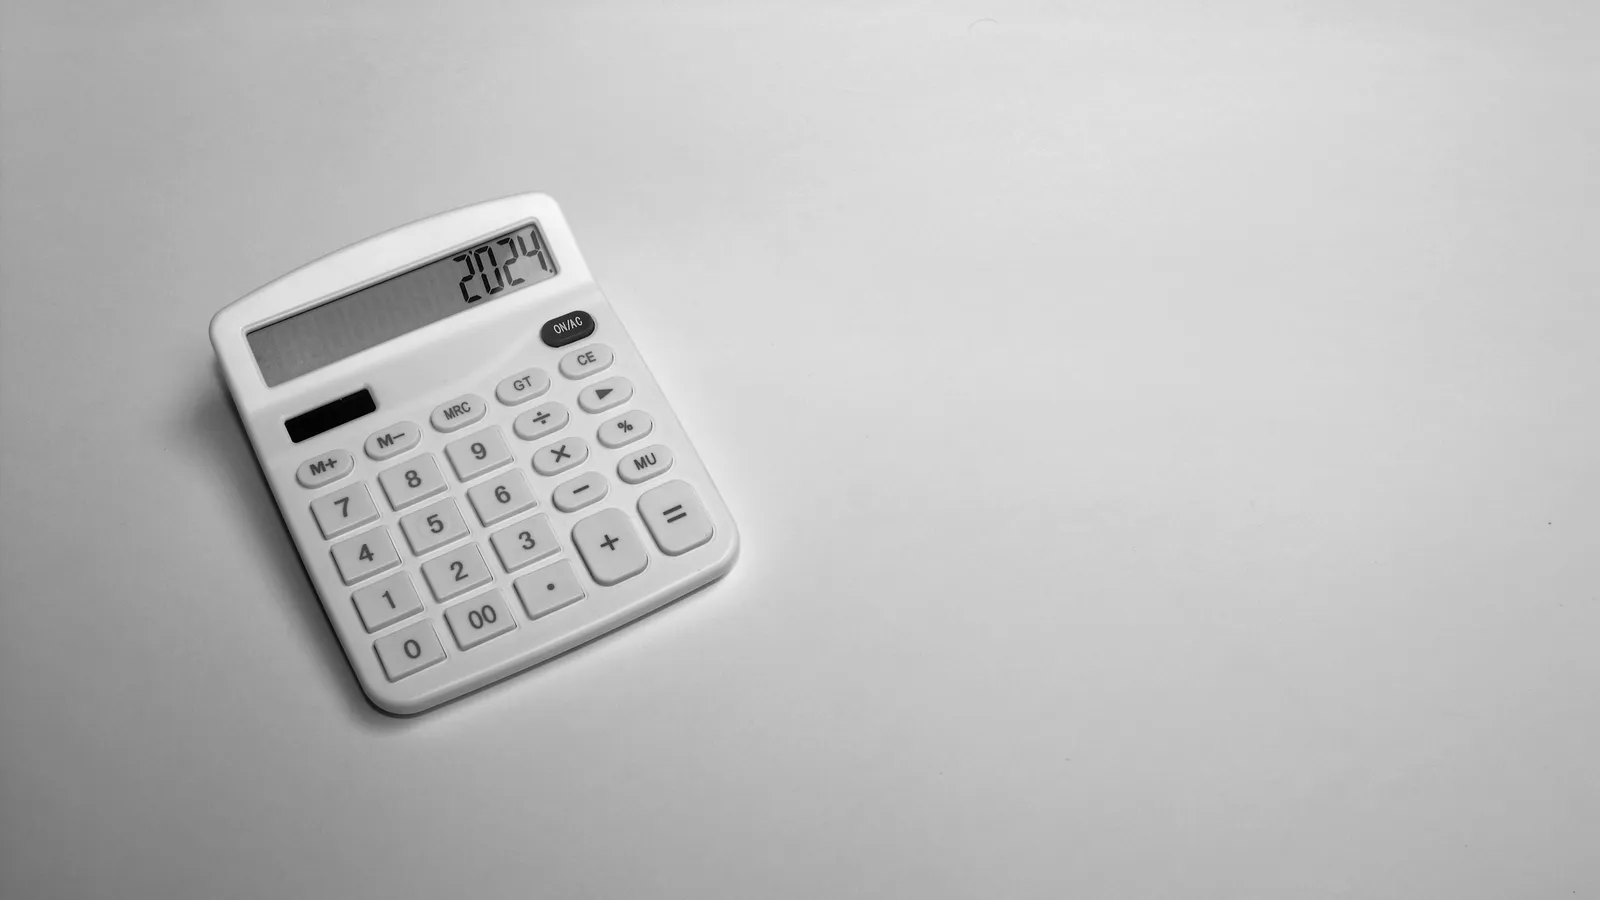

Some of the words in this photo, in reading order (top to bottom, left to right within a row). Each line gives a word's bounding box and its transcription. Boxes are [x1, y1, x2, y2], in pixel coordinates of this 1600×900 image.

[553, 316, 583, 335] ON/AC
[576, 350, 597, 366] CE
[512, 375, 532, 392] GT
[442, 401, 471, 421] MRC
[470, 442, 487, 461] 9
[309, 458, 338, 476] M+
[633, 452, 657, 471] MU
[404, 469, 422, 489] 8
[494, 485, 511, 504] 6
[333, 496, 350, 518] 7
[426, 513, 445, 534] 5
[518, 531, 536, 551] 3
[358, 543, 375, 562] 4
[449, 560, 469, 582] 2
[381, 590, 397, 609] 1
[467, 604, 497, 630] 00
[403, 638, 422, 660] 0
